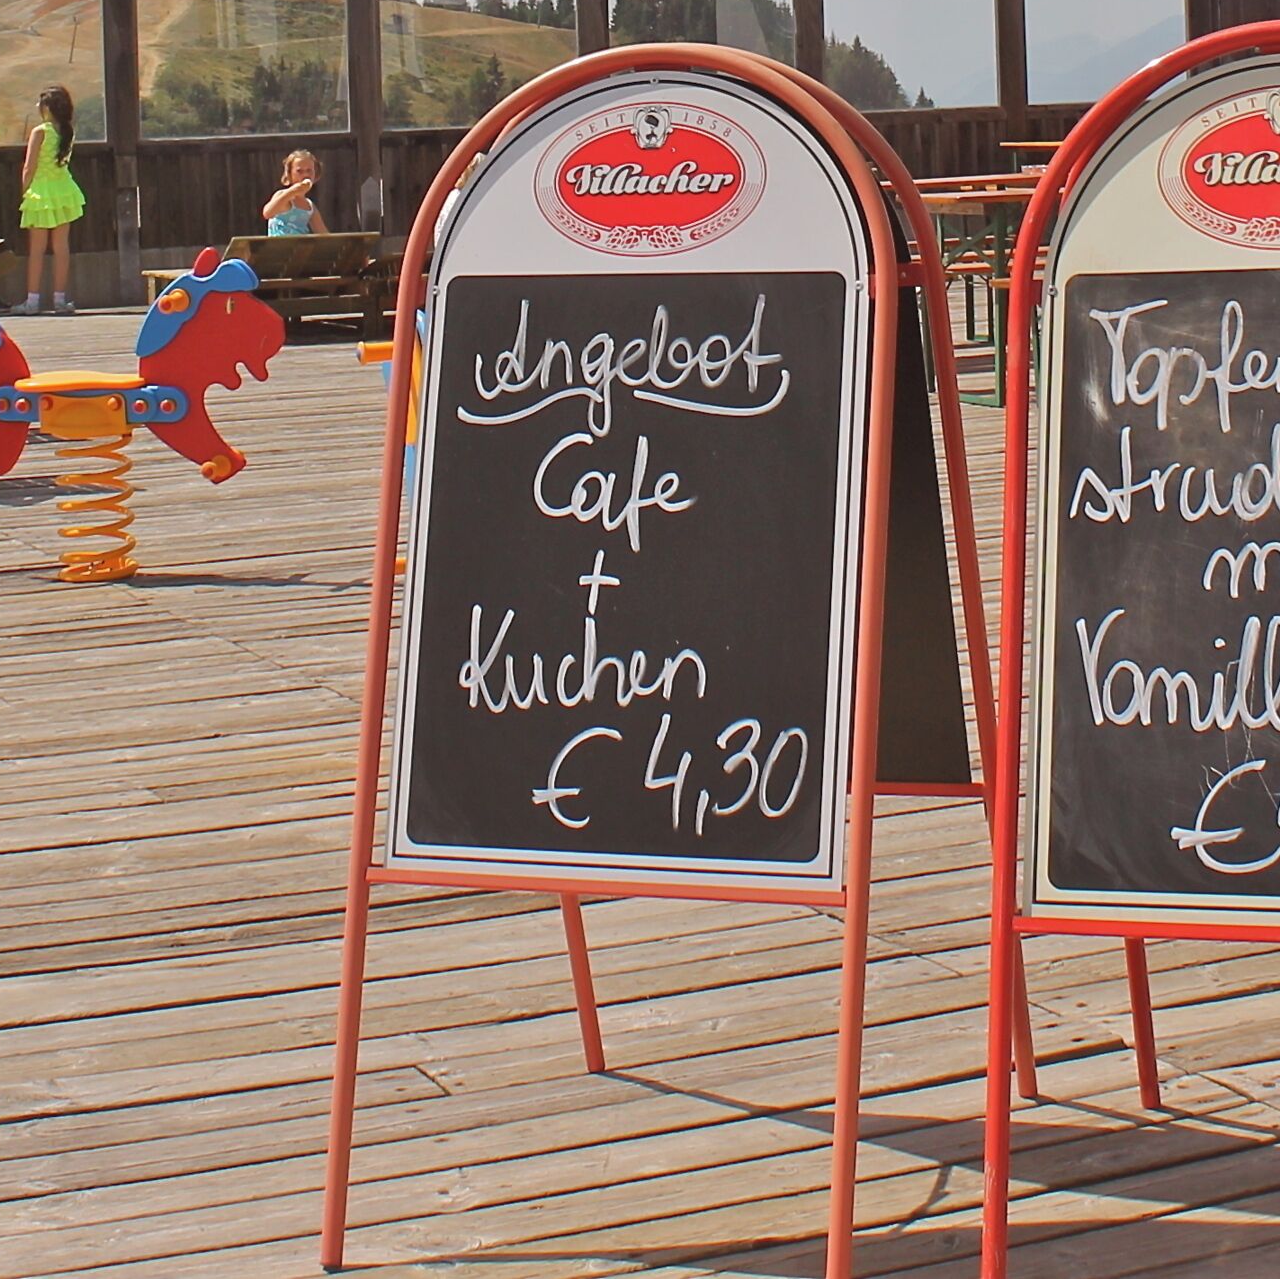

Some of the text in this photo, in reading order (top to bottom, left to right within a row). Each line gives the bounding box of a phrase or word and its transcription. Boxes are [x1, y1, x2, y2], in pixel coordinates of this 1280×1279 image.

[575, 111, 733, 141] SEIT 1858
[1200, 97, 1258, 128] SEIT
[565, 160, 735, 197] Villacher
[459, 604, 707, 714] Kuchen
